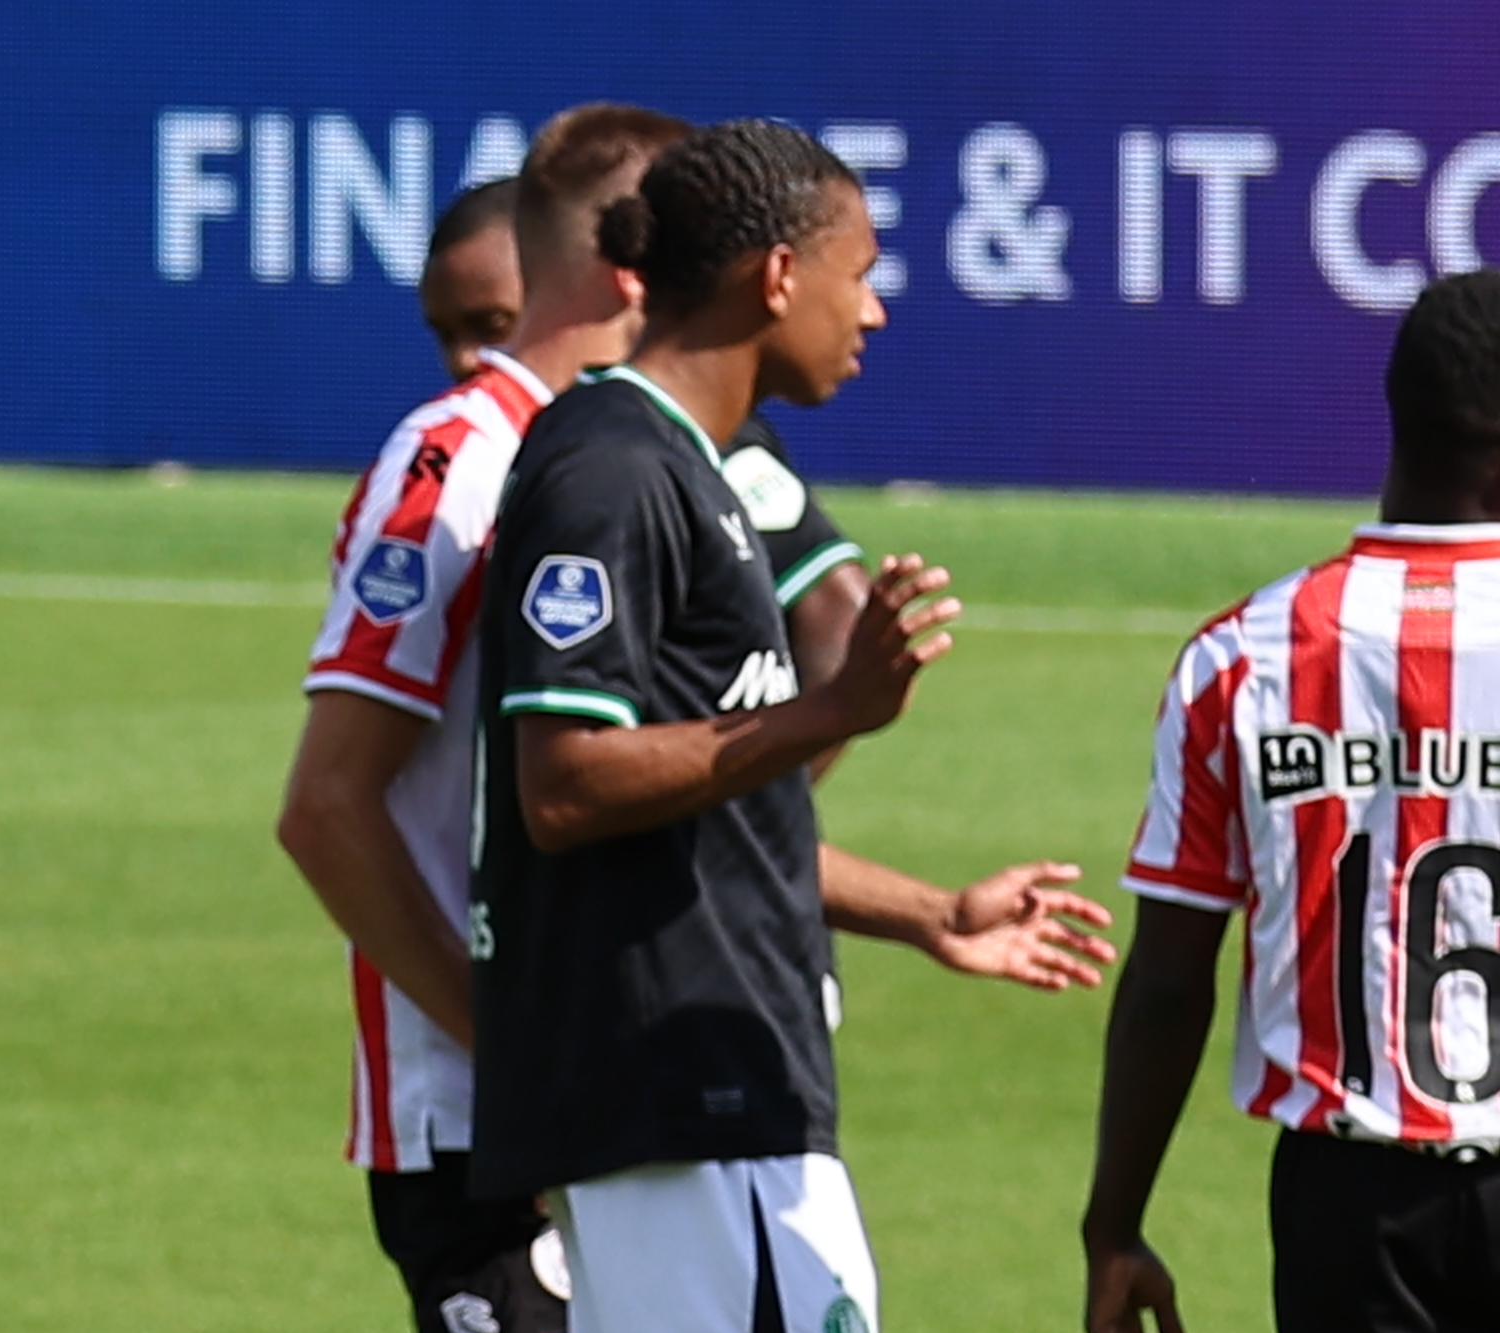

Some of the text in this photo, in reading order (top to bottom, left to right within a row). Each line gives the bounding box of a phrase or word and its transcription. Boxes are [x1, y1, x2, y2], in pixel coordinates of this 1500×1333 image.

[154, 108, 909, 298] FINE
[946, 120, 1073, 304] &
[1117, 125, 1279, 306] IT
[1333, 831, 1500, 1105] 16
